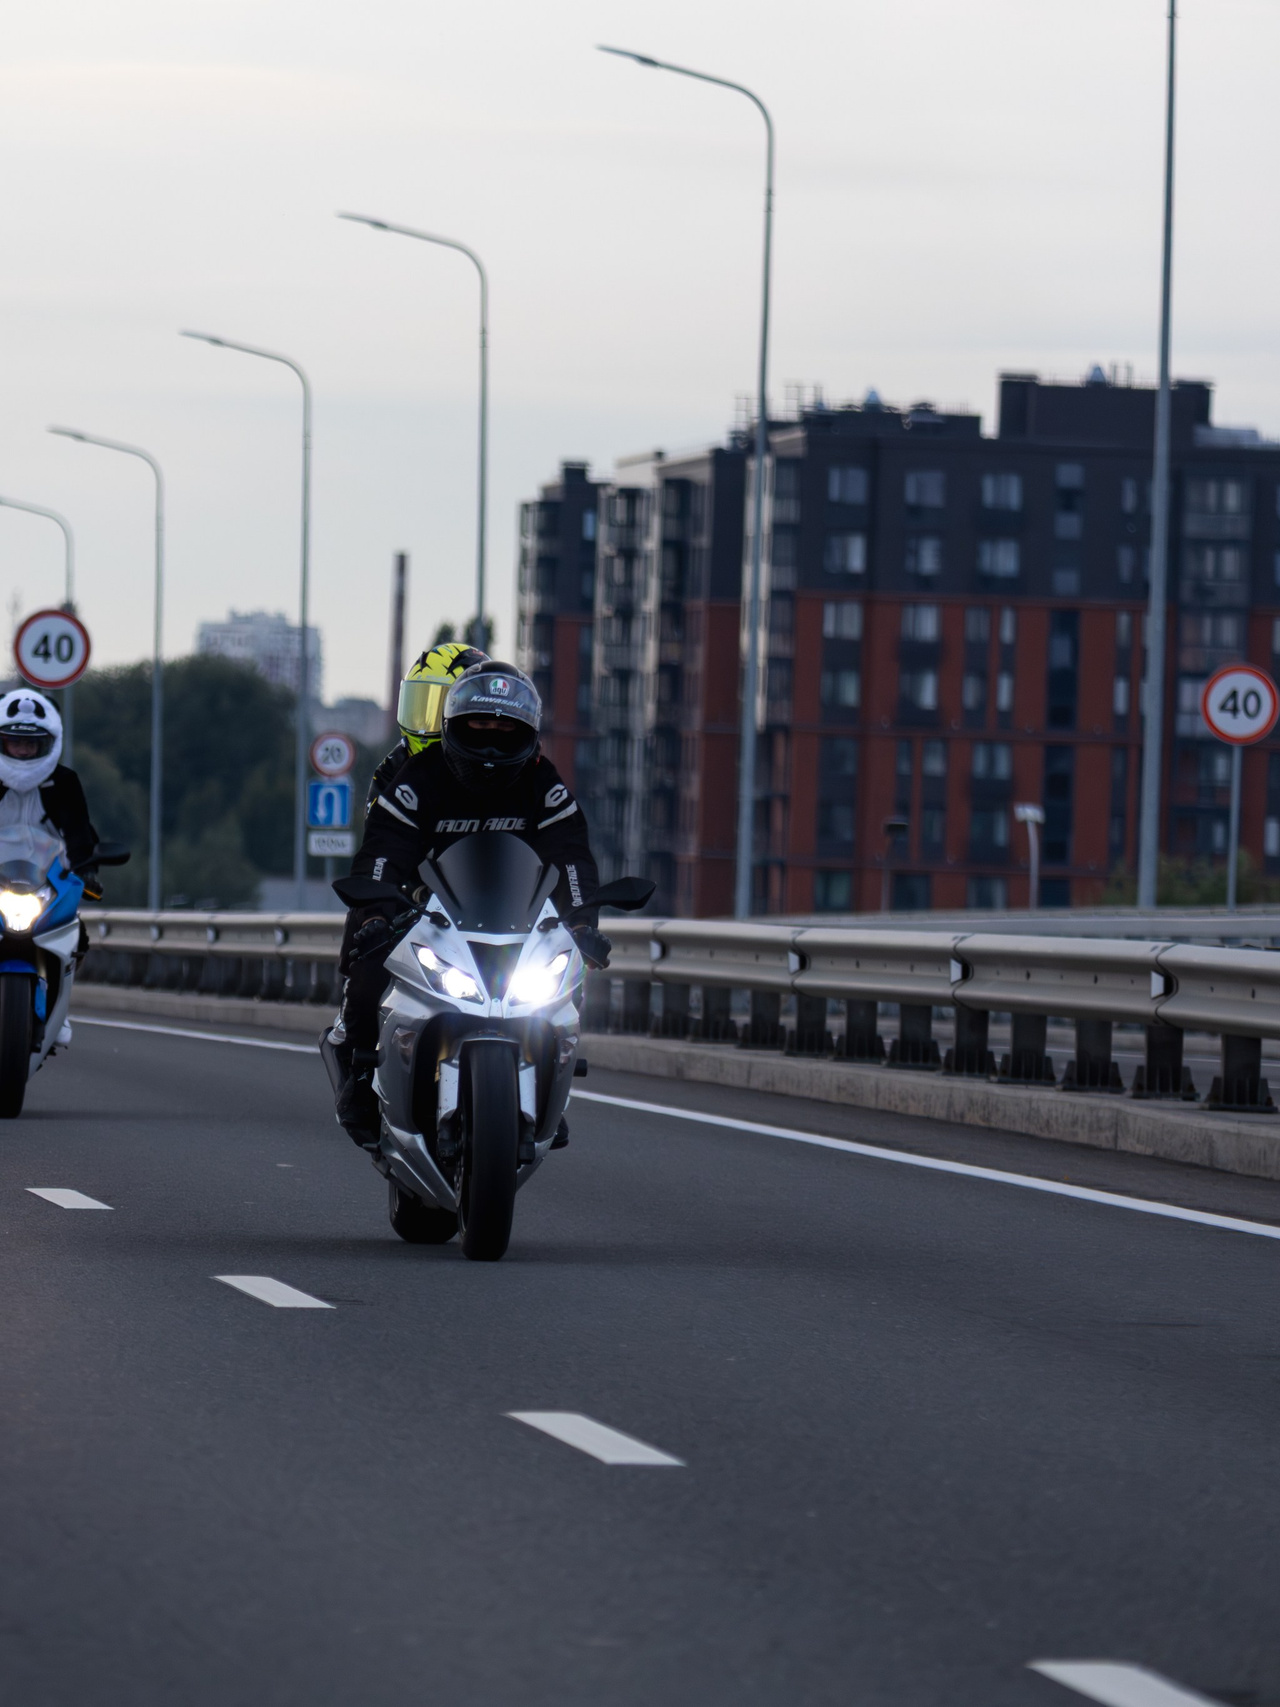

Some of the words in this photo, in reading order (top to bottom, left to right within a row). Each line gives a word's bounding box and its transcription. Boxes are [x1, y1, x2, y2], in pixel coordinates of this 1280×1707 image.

[31, 632, 75, 664] 40
[492, 687, 507, 695] agv
[470, 695, 524, 709] Kawasaki
[1218, 688, 1261, 720] 40
[435, 819, 480, 833] IRON
